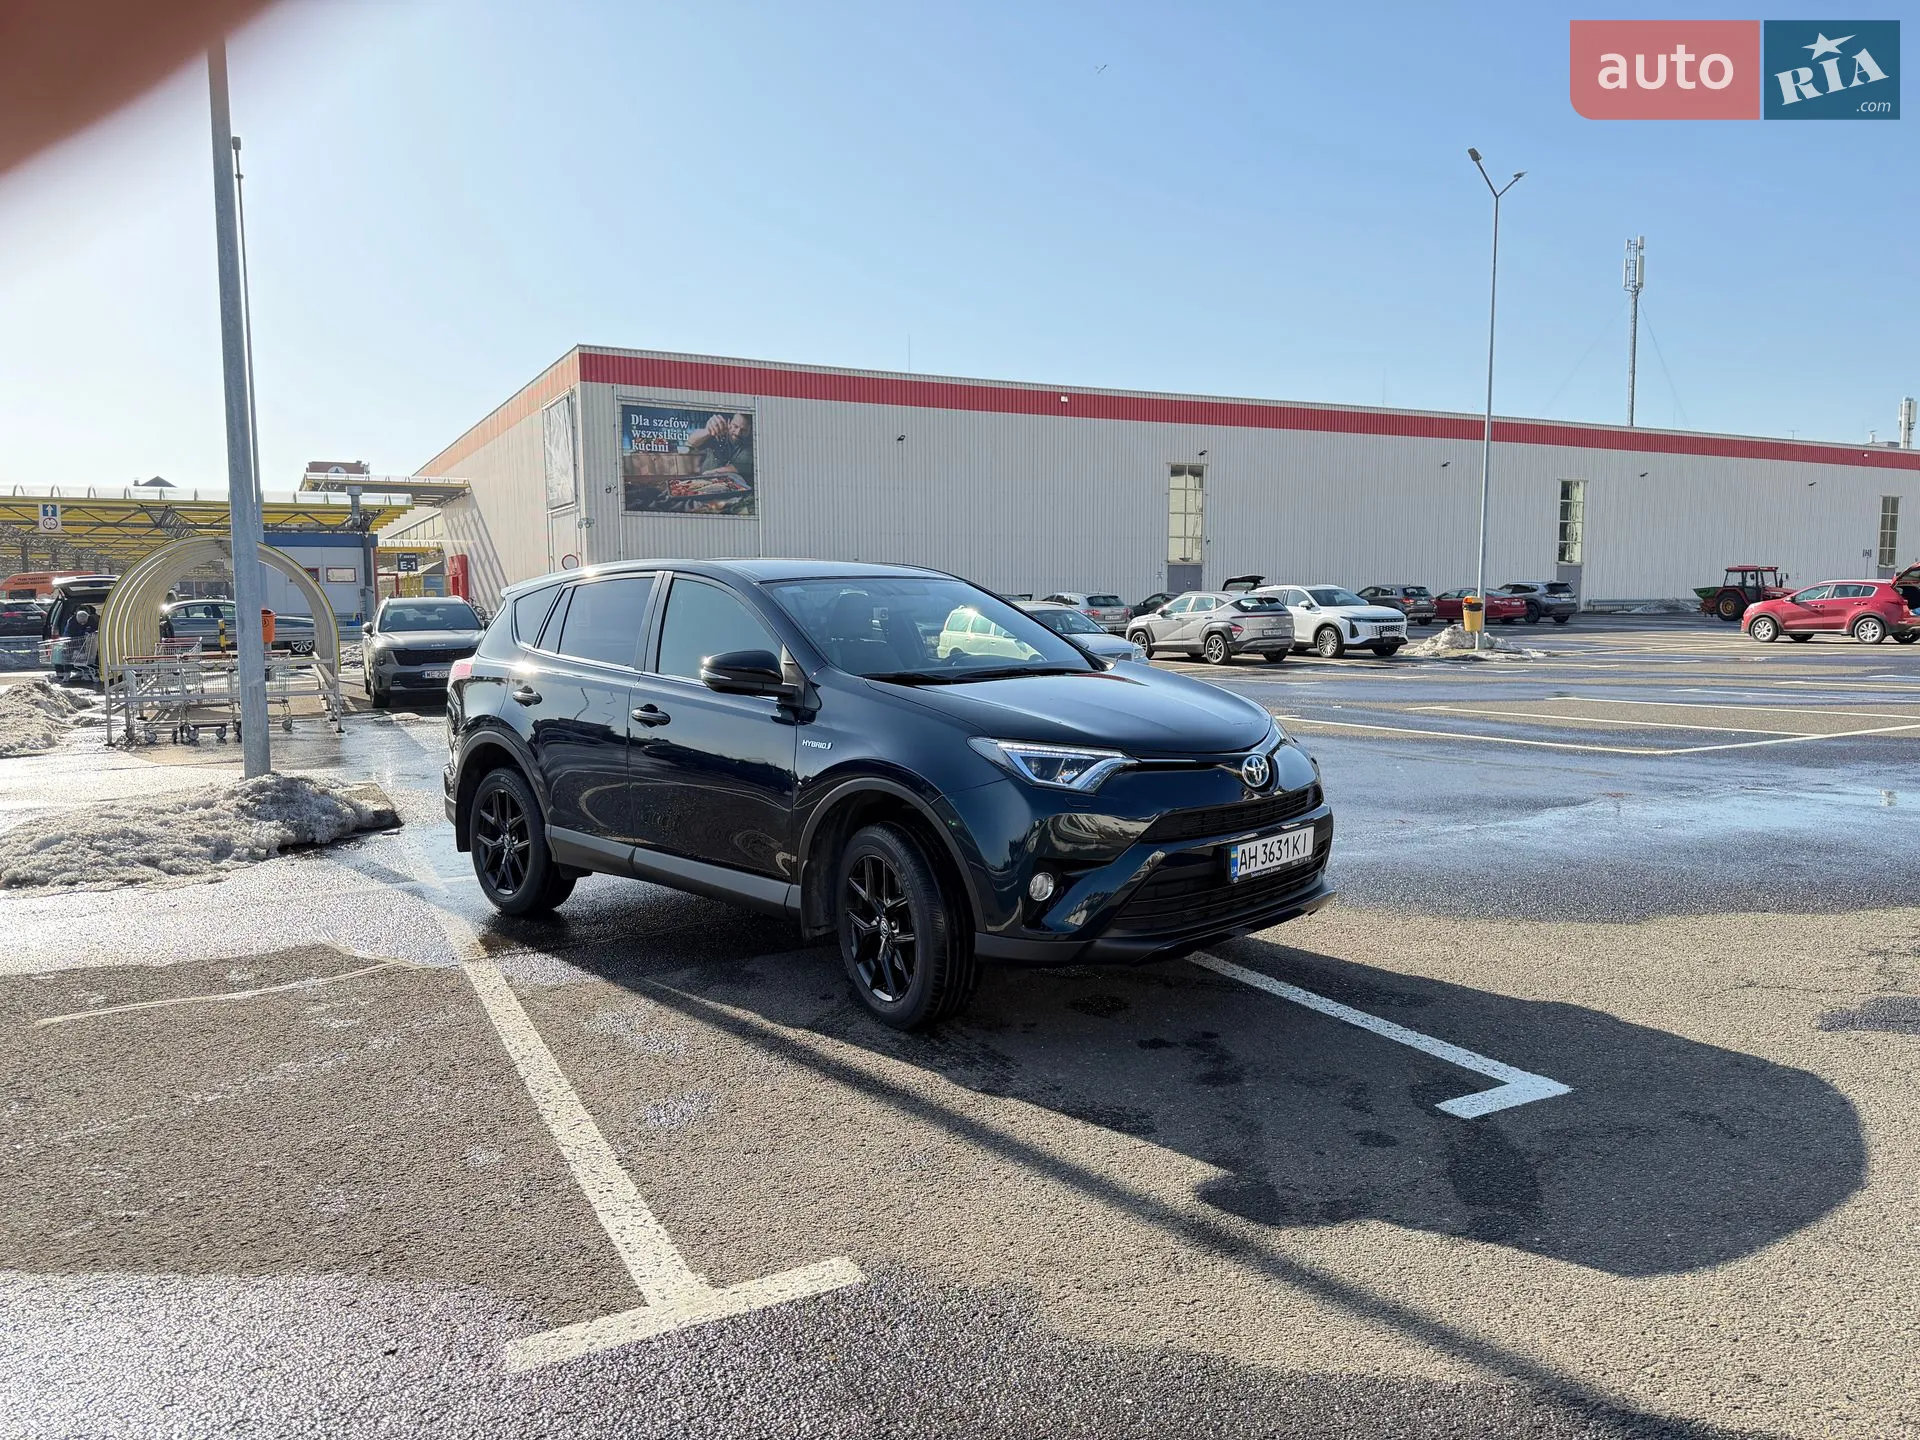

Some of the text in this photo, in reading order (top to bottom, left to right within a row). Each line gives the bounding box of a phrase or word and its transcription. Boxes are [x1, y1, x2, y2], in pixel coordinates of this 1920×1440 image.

[631, 413, 689, 428] Dla szefów
[631, 428, 689, 441] wszystkich
[631, 439, 669, 453] kuchni
[400, 561, 416, 570] E-1
[802, 739, 827, 749] HYBRID
[1239, 845, 1258, 872] AH
[1261, 837, 1290, 865] 3631
[1291, 832, 1307, 857] KI
